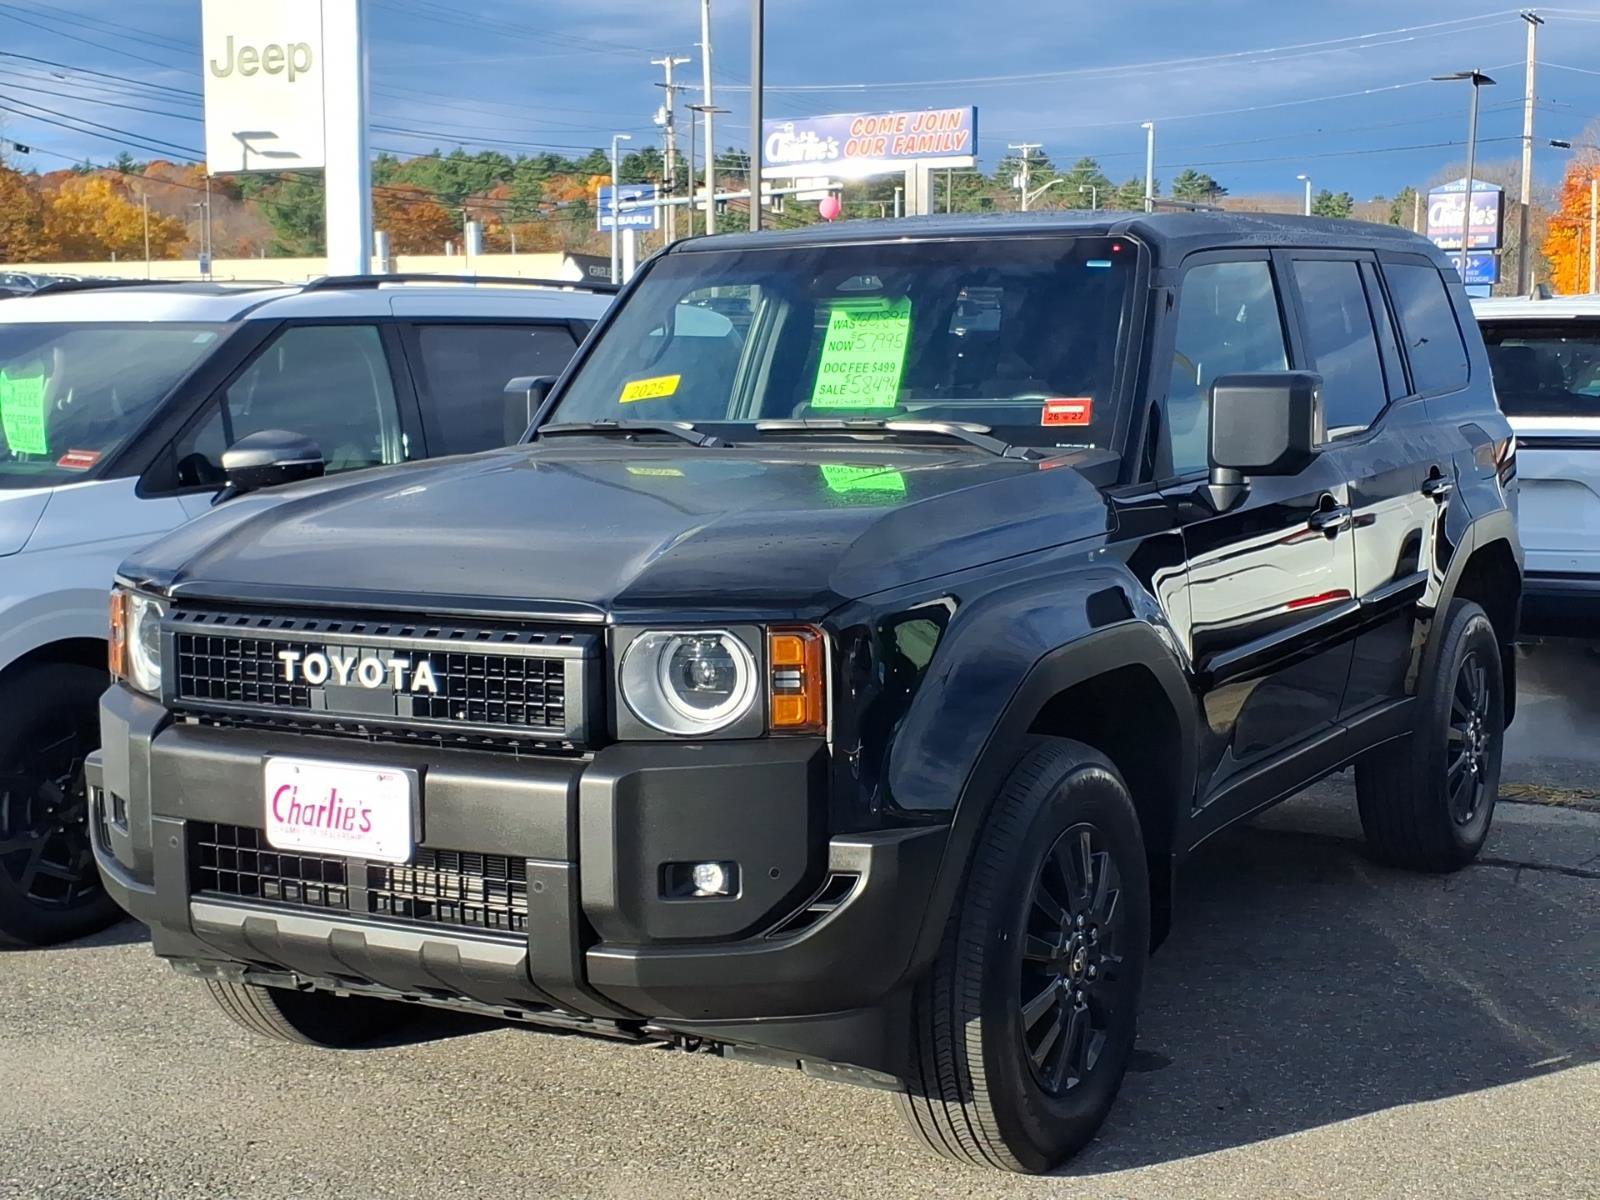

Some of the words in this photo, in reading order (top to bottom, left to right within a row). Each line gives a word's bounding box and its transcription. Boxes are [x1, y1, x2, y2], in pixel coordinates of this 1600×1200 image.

[210, 35, 312, 82] Jeep
[850, 114, 906, 138] COME
[911, 110, 962, 132] JOIN
[844, 138, 886, 157] OUR
[891, 129, 969, 155] FAMILY
[833, 320, 855, 329] WAS
[829, 341, 853, 351] NOW
[824, 363, 847, 373] DOC
[848, 363, 869, 373] FEE
[872, 362, 896, 373] $499
[630, 382, 665, 398] 2025
[819, 384, 847, 395] SALE
[1048, 412, 1059, 420] 26
[1072, 412, 1084, 420] 27
[279, 651, 437, 694] TOYOTA
[273, 784, 372, 833] Charlie's
